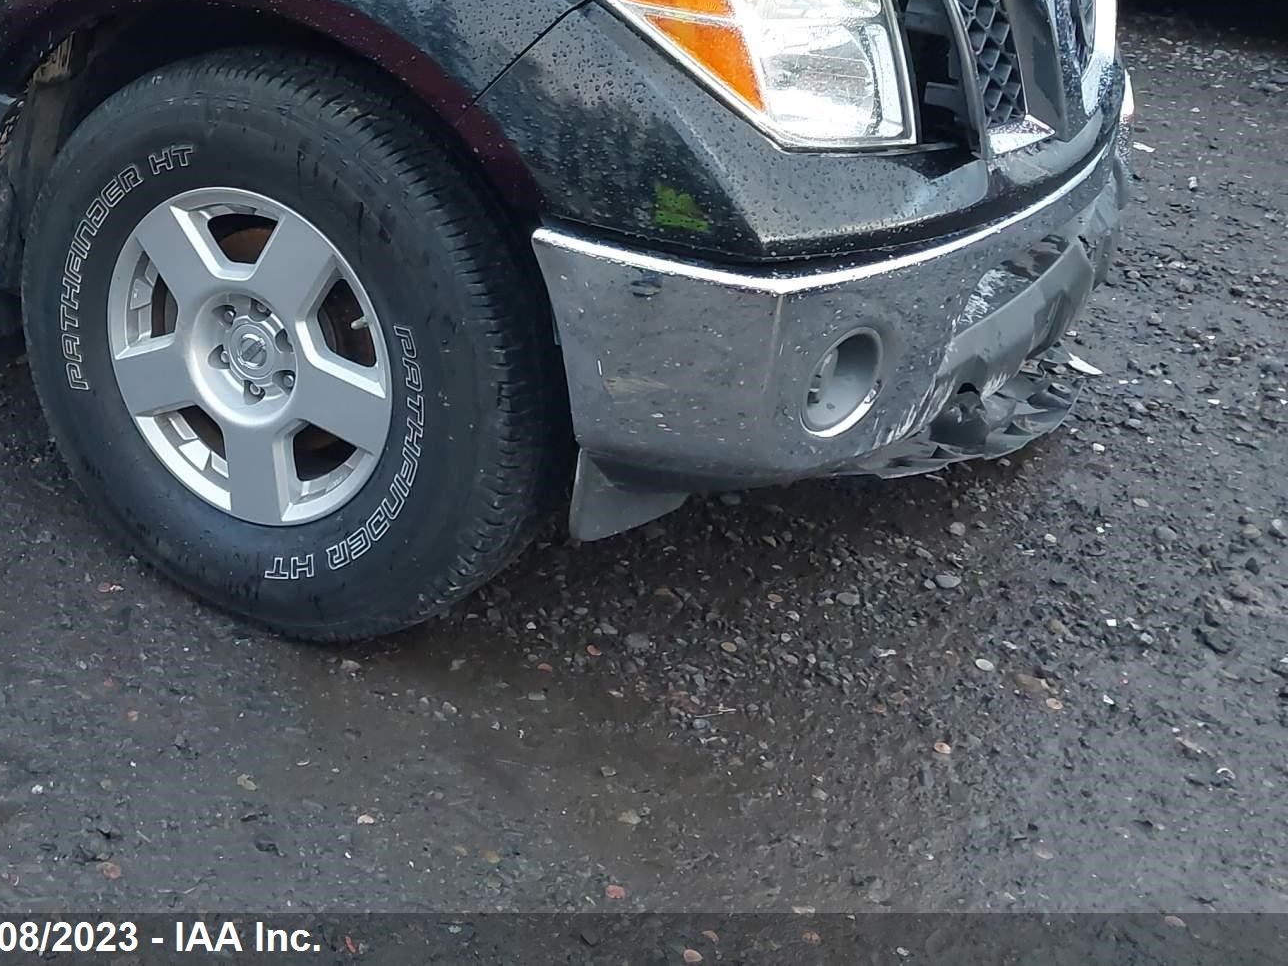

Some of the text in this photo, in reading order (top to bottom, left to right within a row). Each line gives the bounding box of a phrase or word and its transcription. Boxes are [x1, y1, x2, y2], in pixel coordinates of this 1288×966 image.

[59, 145, 195, 392] PATHFINDER HT
[264, 323, 426, 581] PATHFINDER HT
